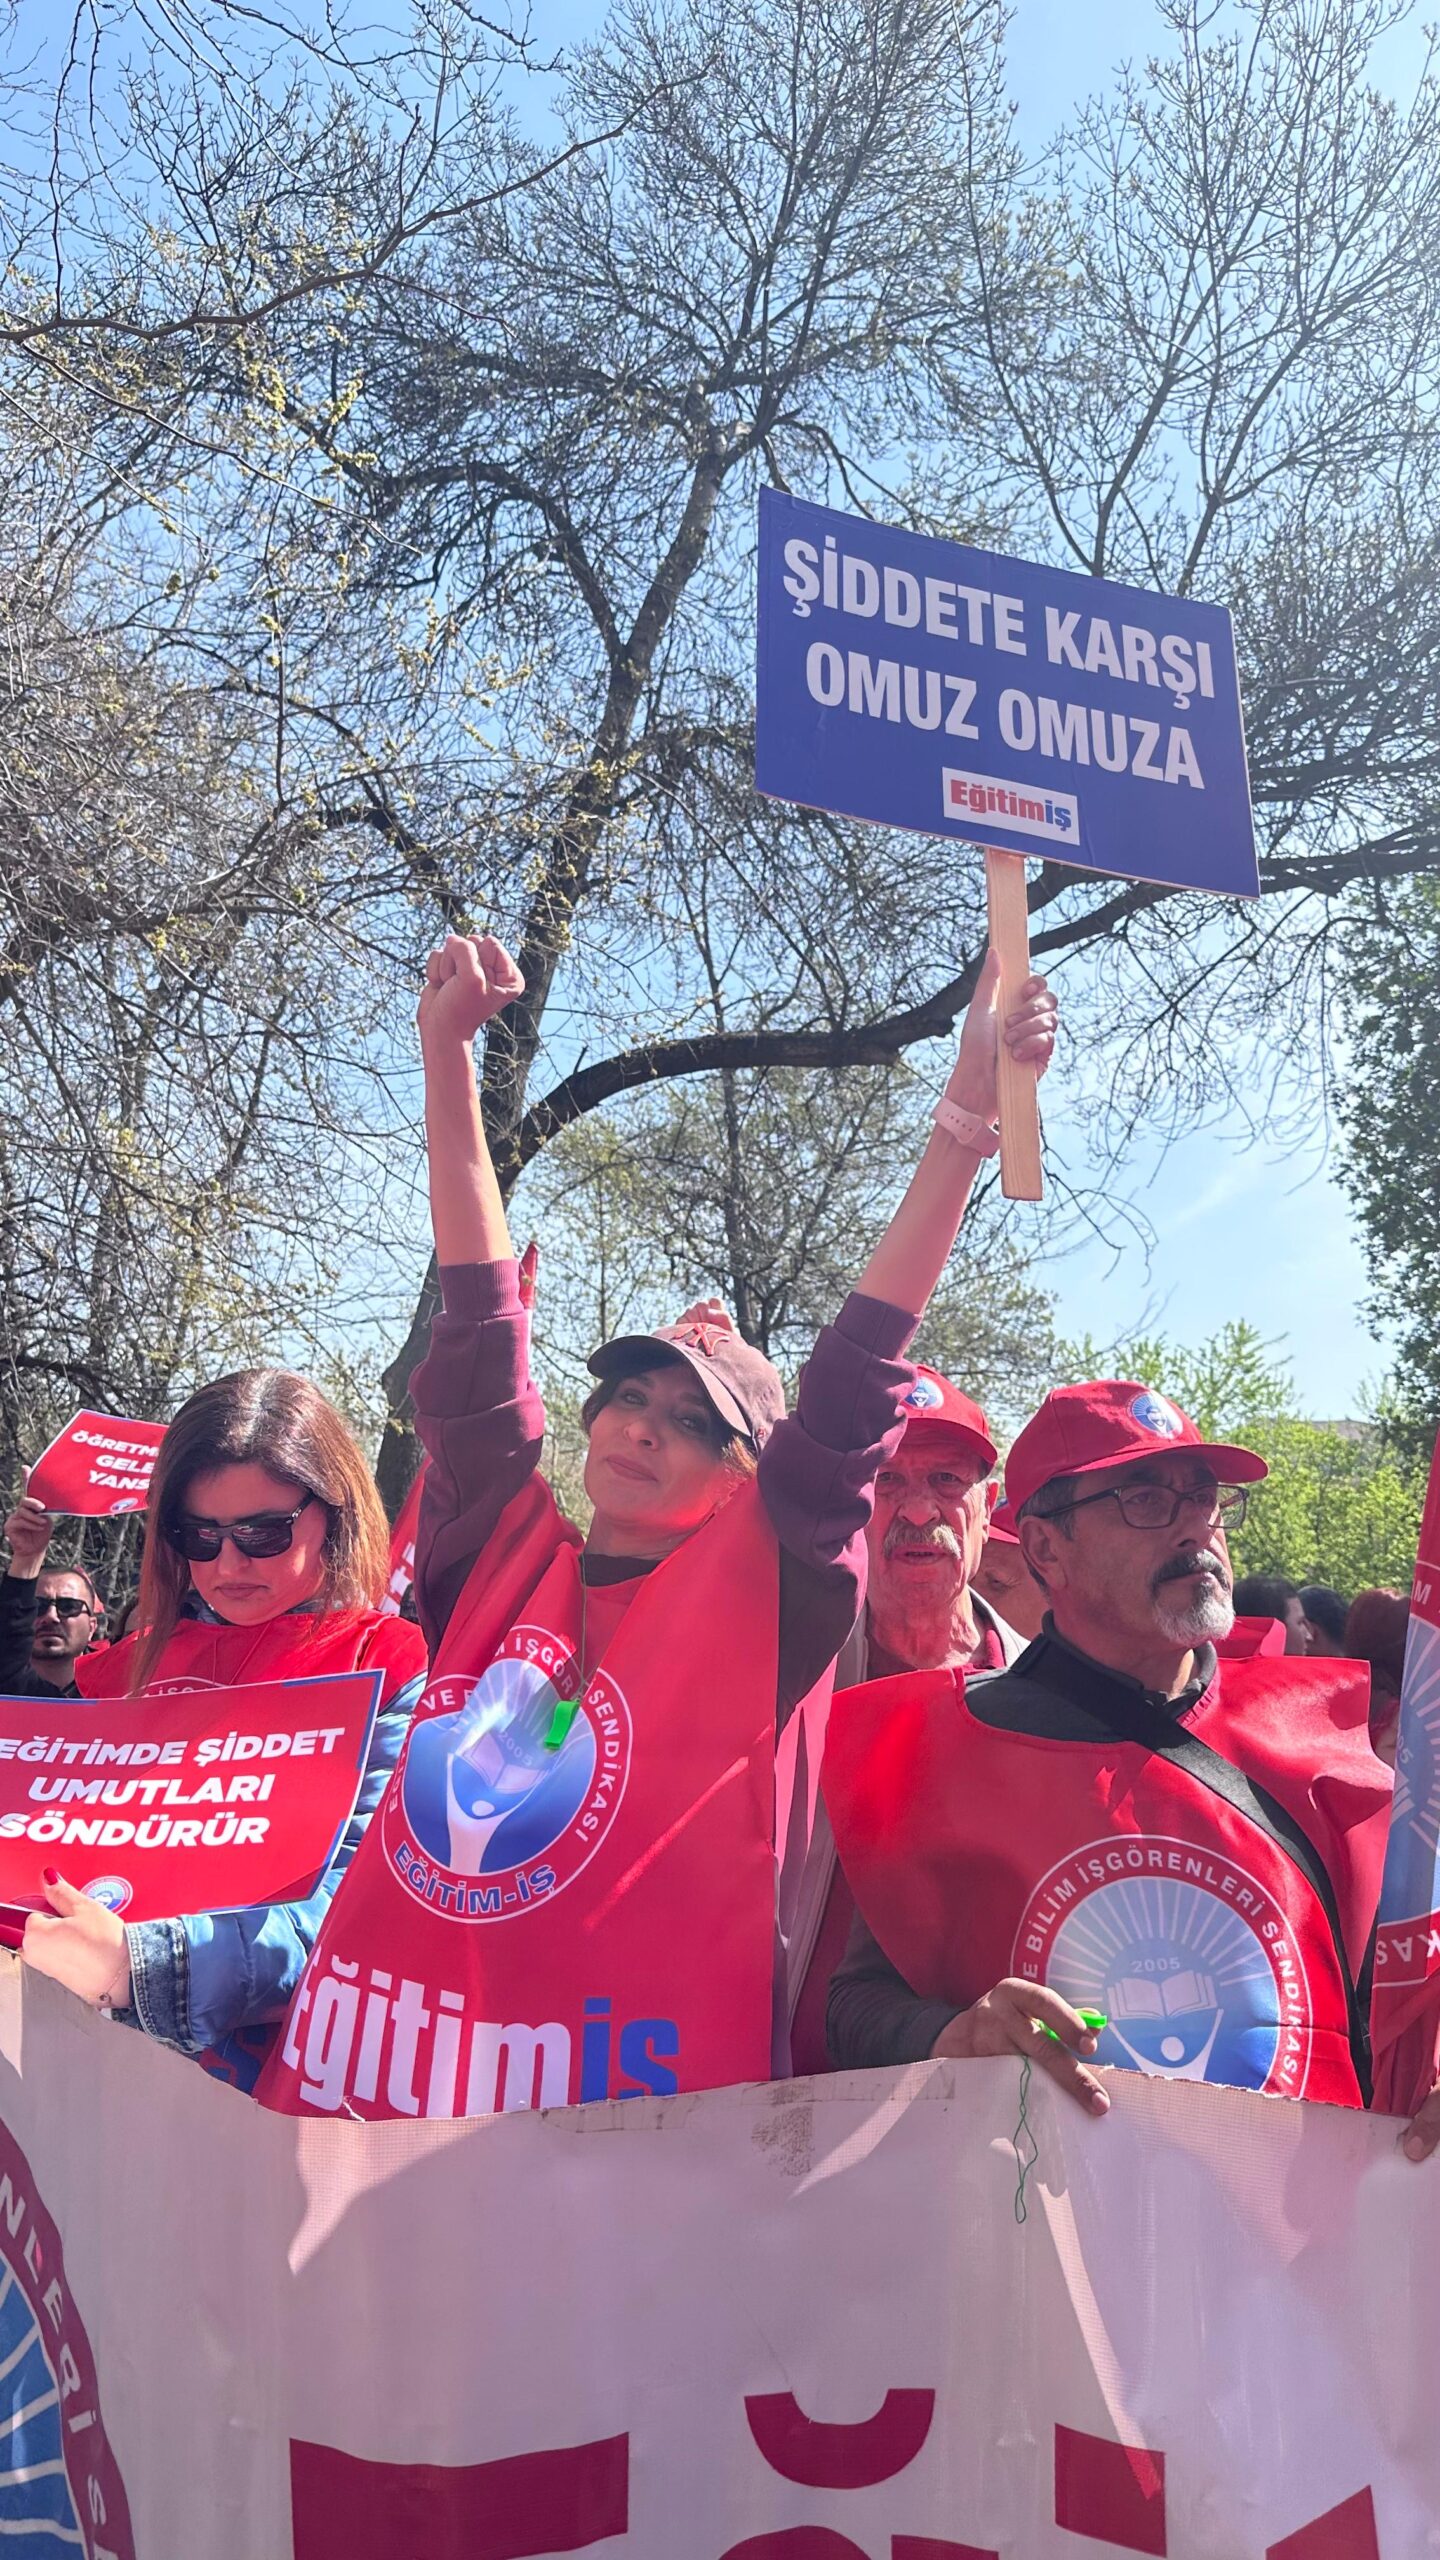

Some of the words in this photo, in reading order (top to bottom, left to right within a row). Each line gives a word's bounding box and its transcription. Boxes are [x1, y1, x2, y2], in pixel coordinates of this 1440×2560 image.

[782, 534, 1028, 656] ŞİDDETE
[1044, 606, 1216, 711] KARŞI
[806, 641, 979, 740] OMUZ
[998, 687, 1206, 790] OMUZA
[71, 1429, 160, 1457] ÖĞRETM
[0, 1735, 188, 1766] EĞİTİMDE
[193, 1727, 346, 1767] ŞİDDET
[28, 1774, 276, 1805] UMUTLARI
[0, 1810, 270, 1848] SÖNDÜRÜR
[394, 1839, 557, 1915] EĞİTİM-İŞ
[1026, 1878, 1077, 1953] BİLİM
[1077, 1844, 1267, 1918] İŞGÖRENLERİ
[1262, 1920, 1305, 2086] SENDİKASI
[1131, 1955, 1181, 1975] 2005
